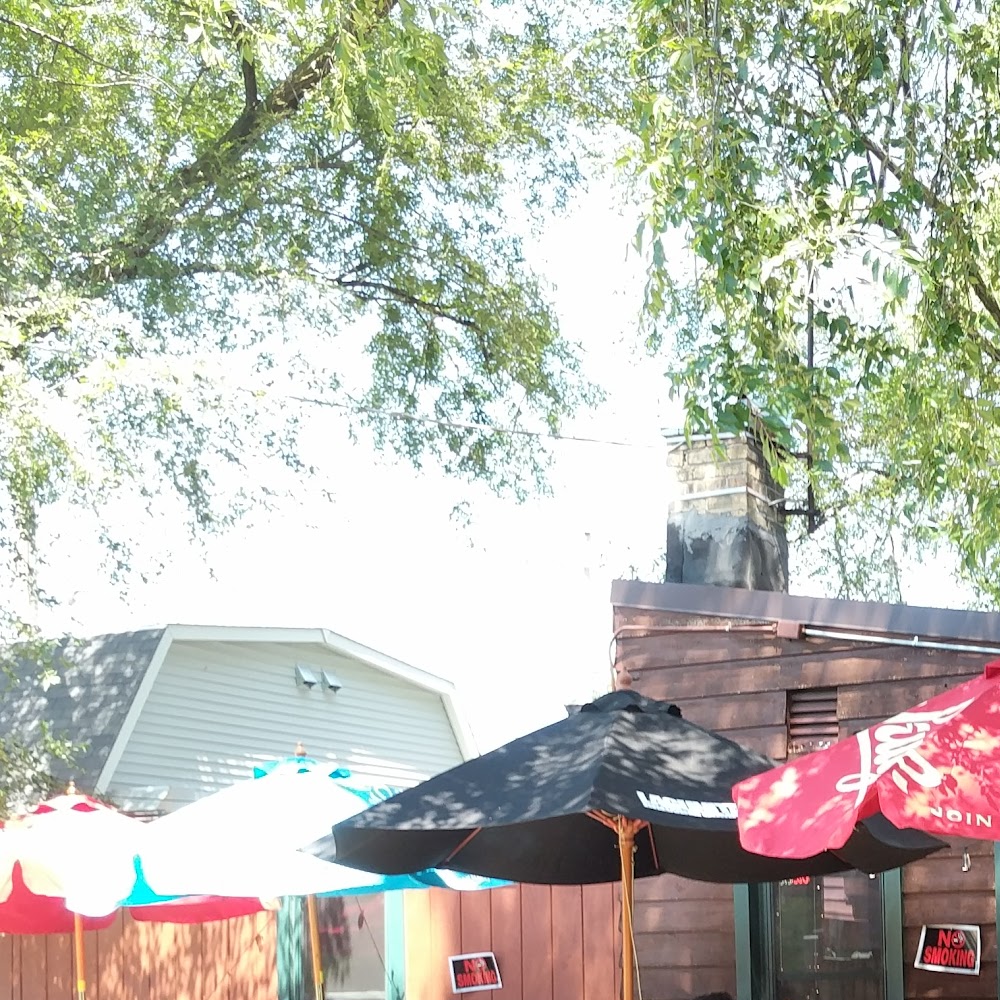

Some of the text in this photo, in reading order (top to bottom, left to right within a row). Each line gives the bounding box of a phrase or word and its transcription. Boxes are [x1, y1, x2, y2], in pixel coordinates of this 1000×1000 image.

[930, 806, 992, 828] JOIN
[937, 928, 967, 949] NO
[463, 957, 487, 973] NO
[923, 945, 975, 968] SMOKING
